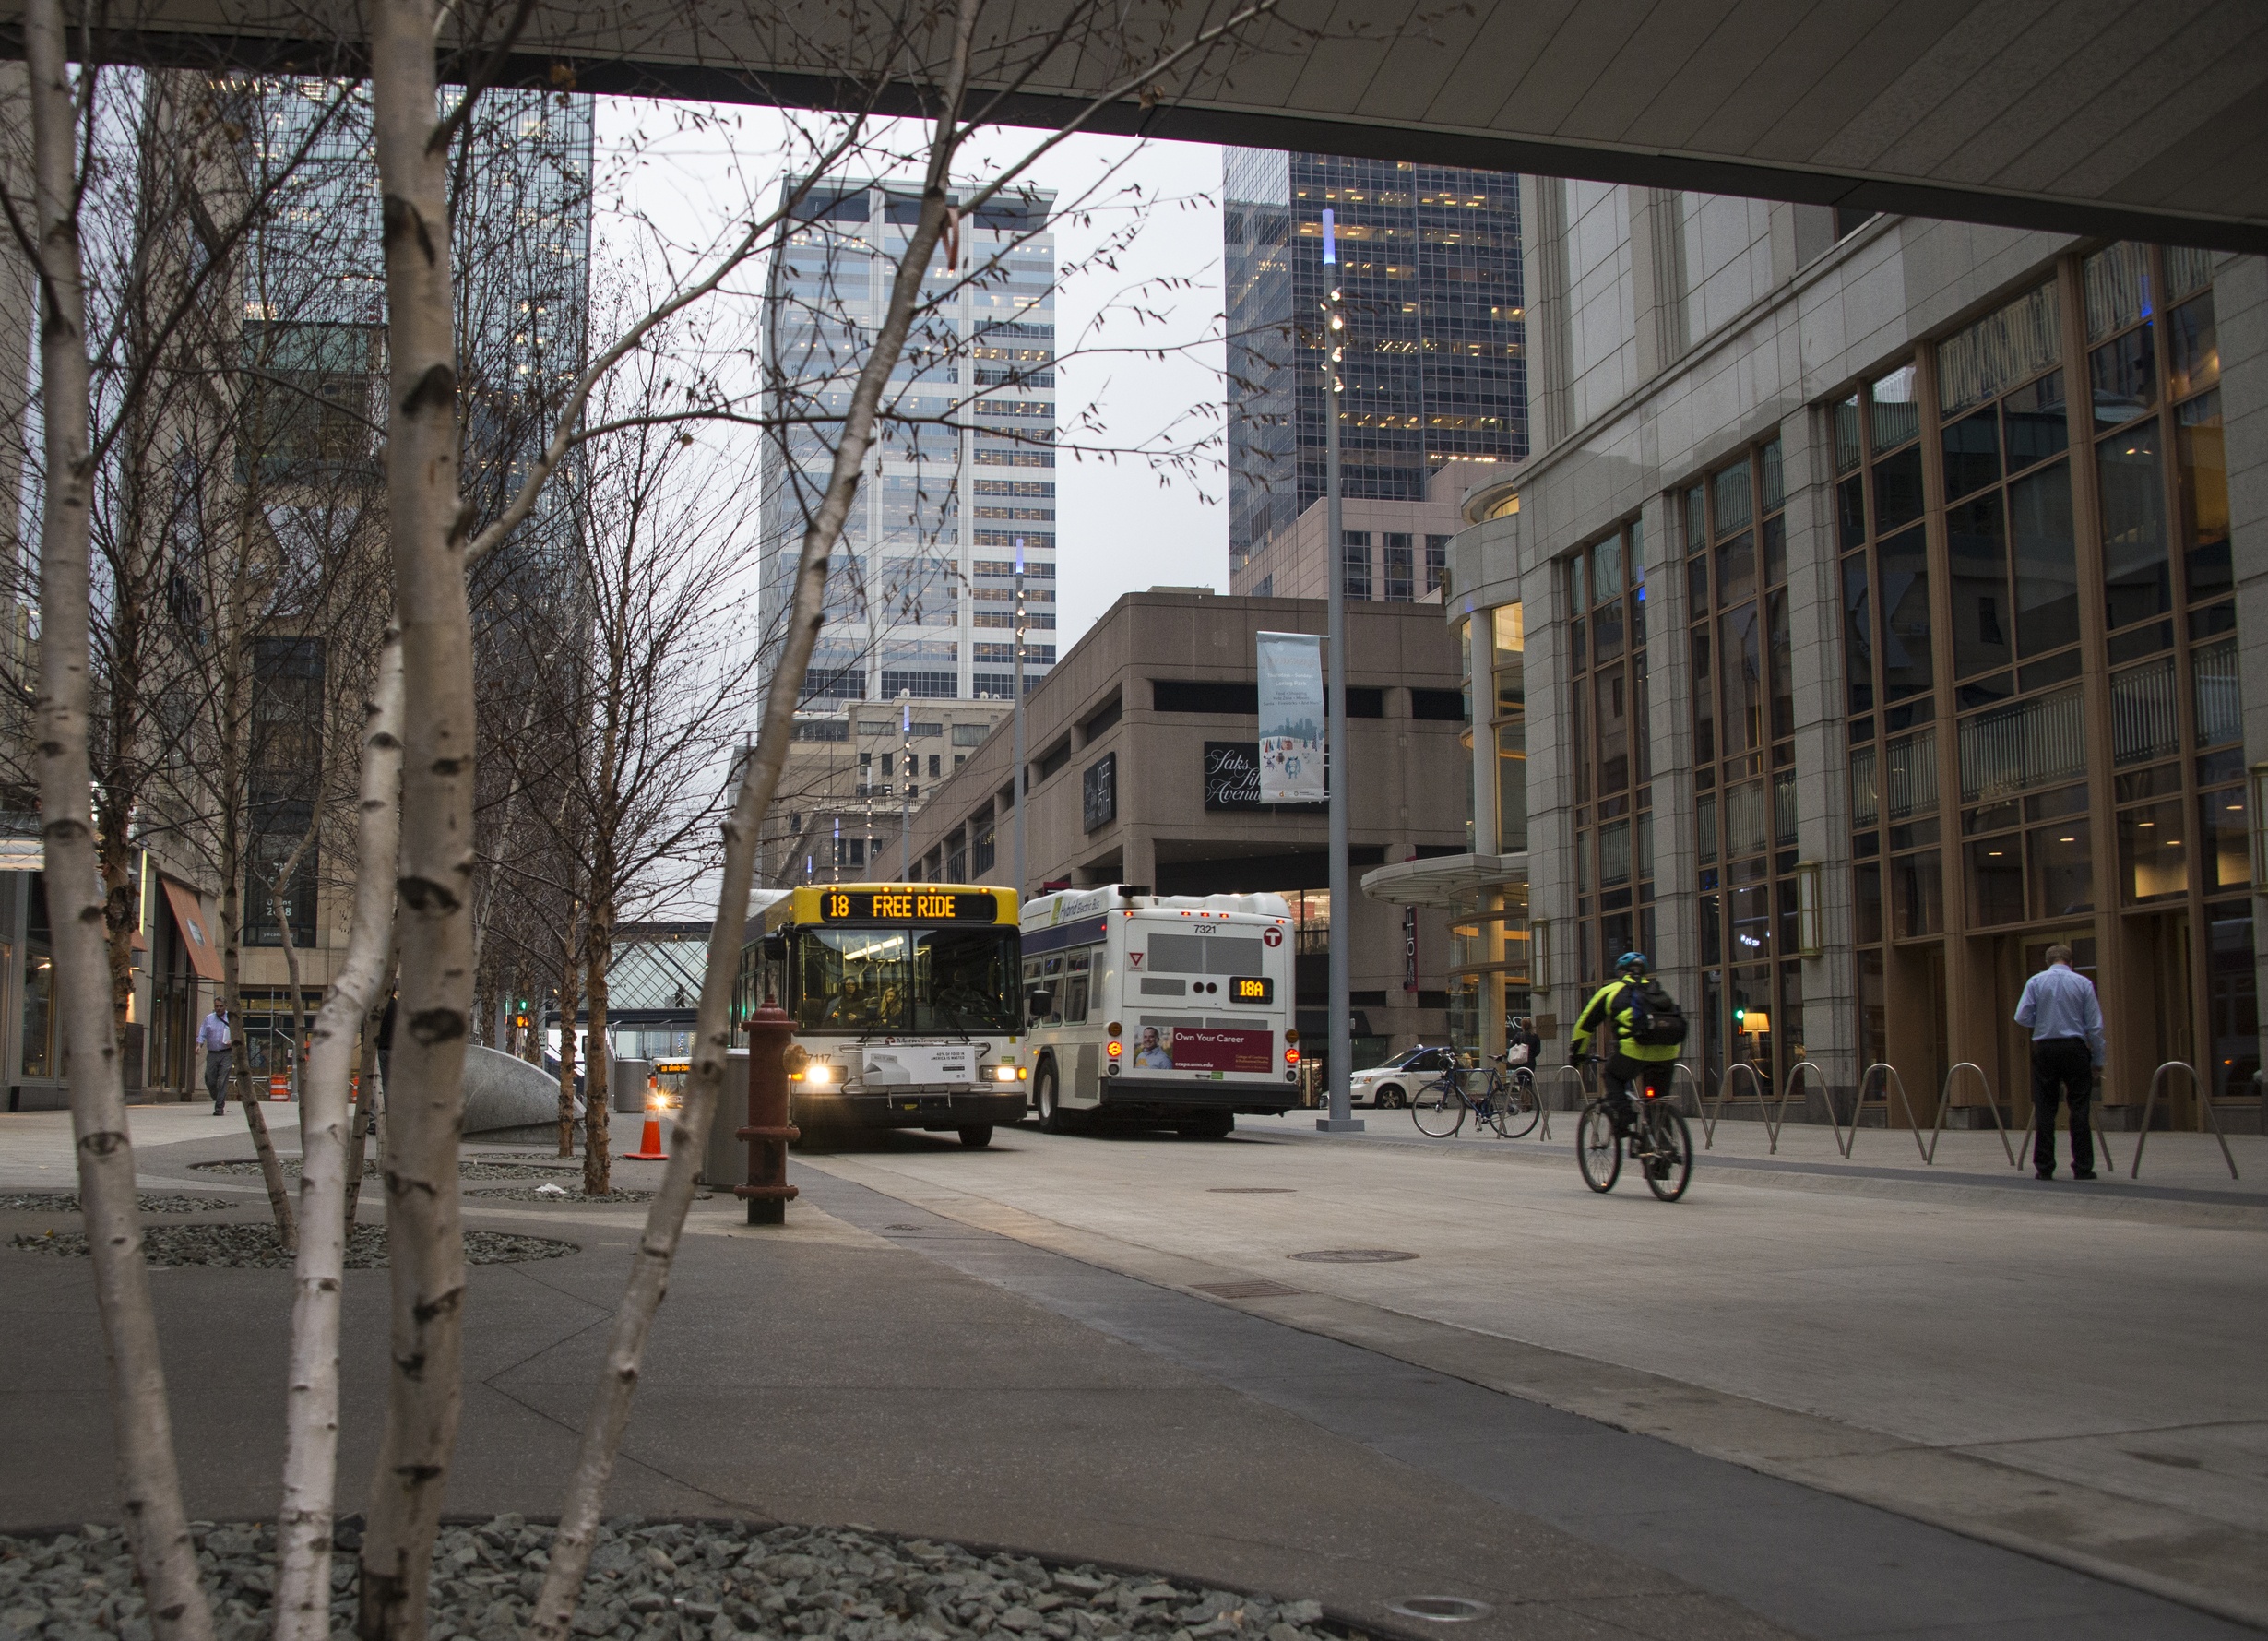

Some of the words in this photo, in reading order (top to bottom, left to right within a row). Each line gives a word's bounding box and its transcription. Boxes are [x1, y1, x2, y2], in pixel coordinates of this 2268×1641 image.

[1205, 749, 1249, 775] Saks
[1098, 760, 1110, 791] OFF
[1205, 778, 1260, 803] Avenu
[1098, 787, 1110, 817] 5TH
[267, 898, 292, 907] Ons
[267, 907, 291, 917] 28
[830, 894, 849, 917] 18
[873, 895, 912, 917] FREE
[917, 895, 956, 917] RIDE
[1061, 899, 1079, 922] Hybrid
[1077, 900, 1092, 914] Electric
[1091, 898, 1100, 910] Bus
[1193, 924, 1217, 934] 7321
[1240, 981, 1264, 997] 18A
[1175, 1032, 1194, 1041] Own
[1197, 1033, 1215, 1042] Your
[1217, 1034, 1244, 1043] Career
[807, 1053, 831, 1064] 7117
